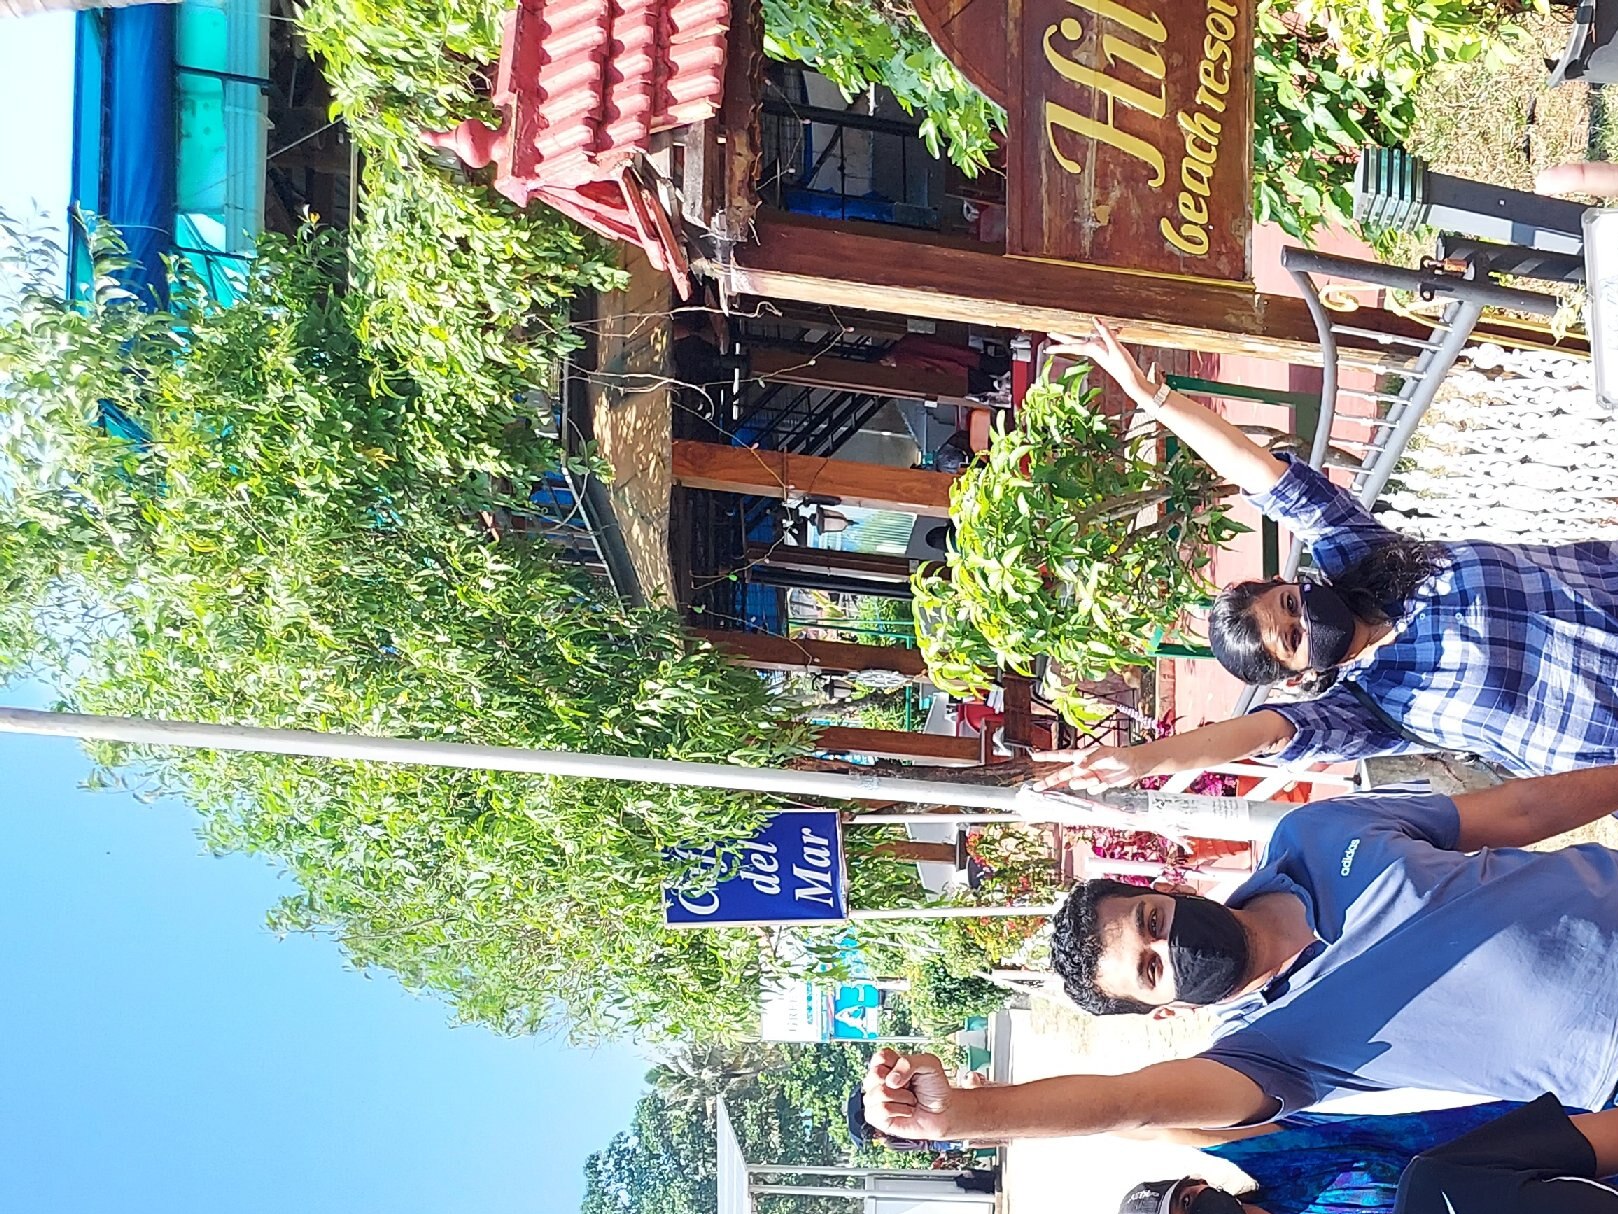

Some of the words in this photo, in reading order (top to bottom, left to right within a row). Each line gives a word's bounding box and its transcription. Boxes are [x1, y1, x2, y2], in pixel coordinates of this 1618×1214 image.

[1160, 111, 1222, 256] beach
[738, 841, 780, 894] del
[793, 827, 834, 907] Mar
[1340, 839, 1361, 877] adidas
